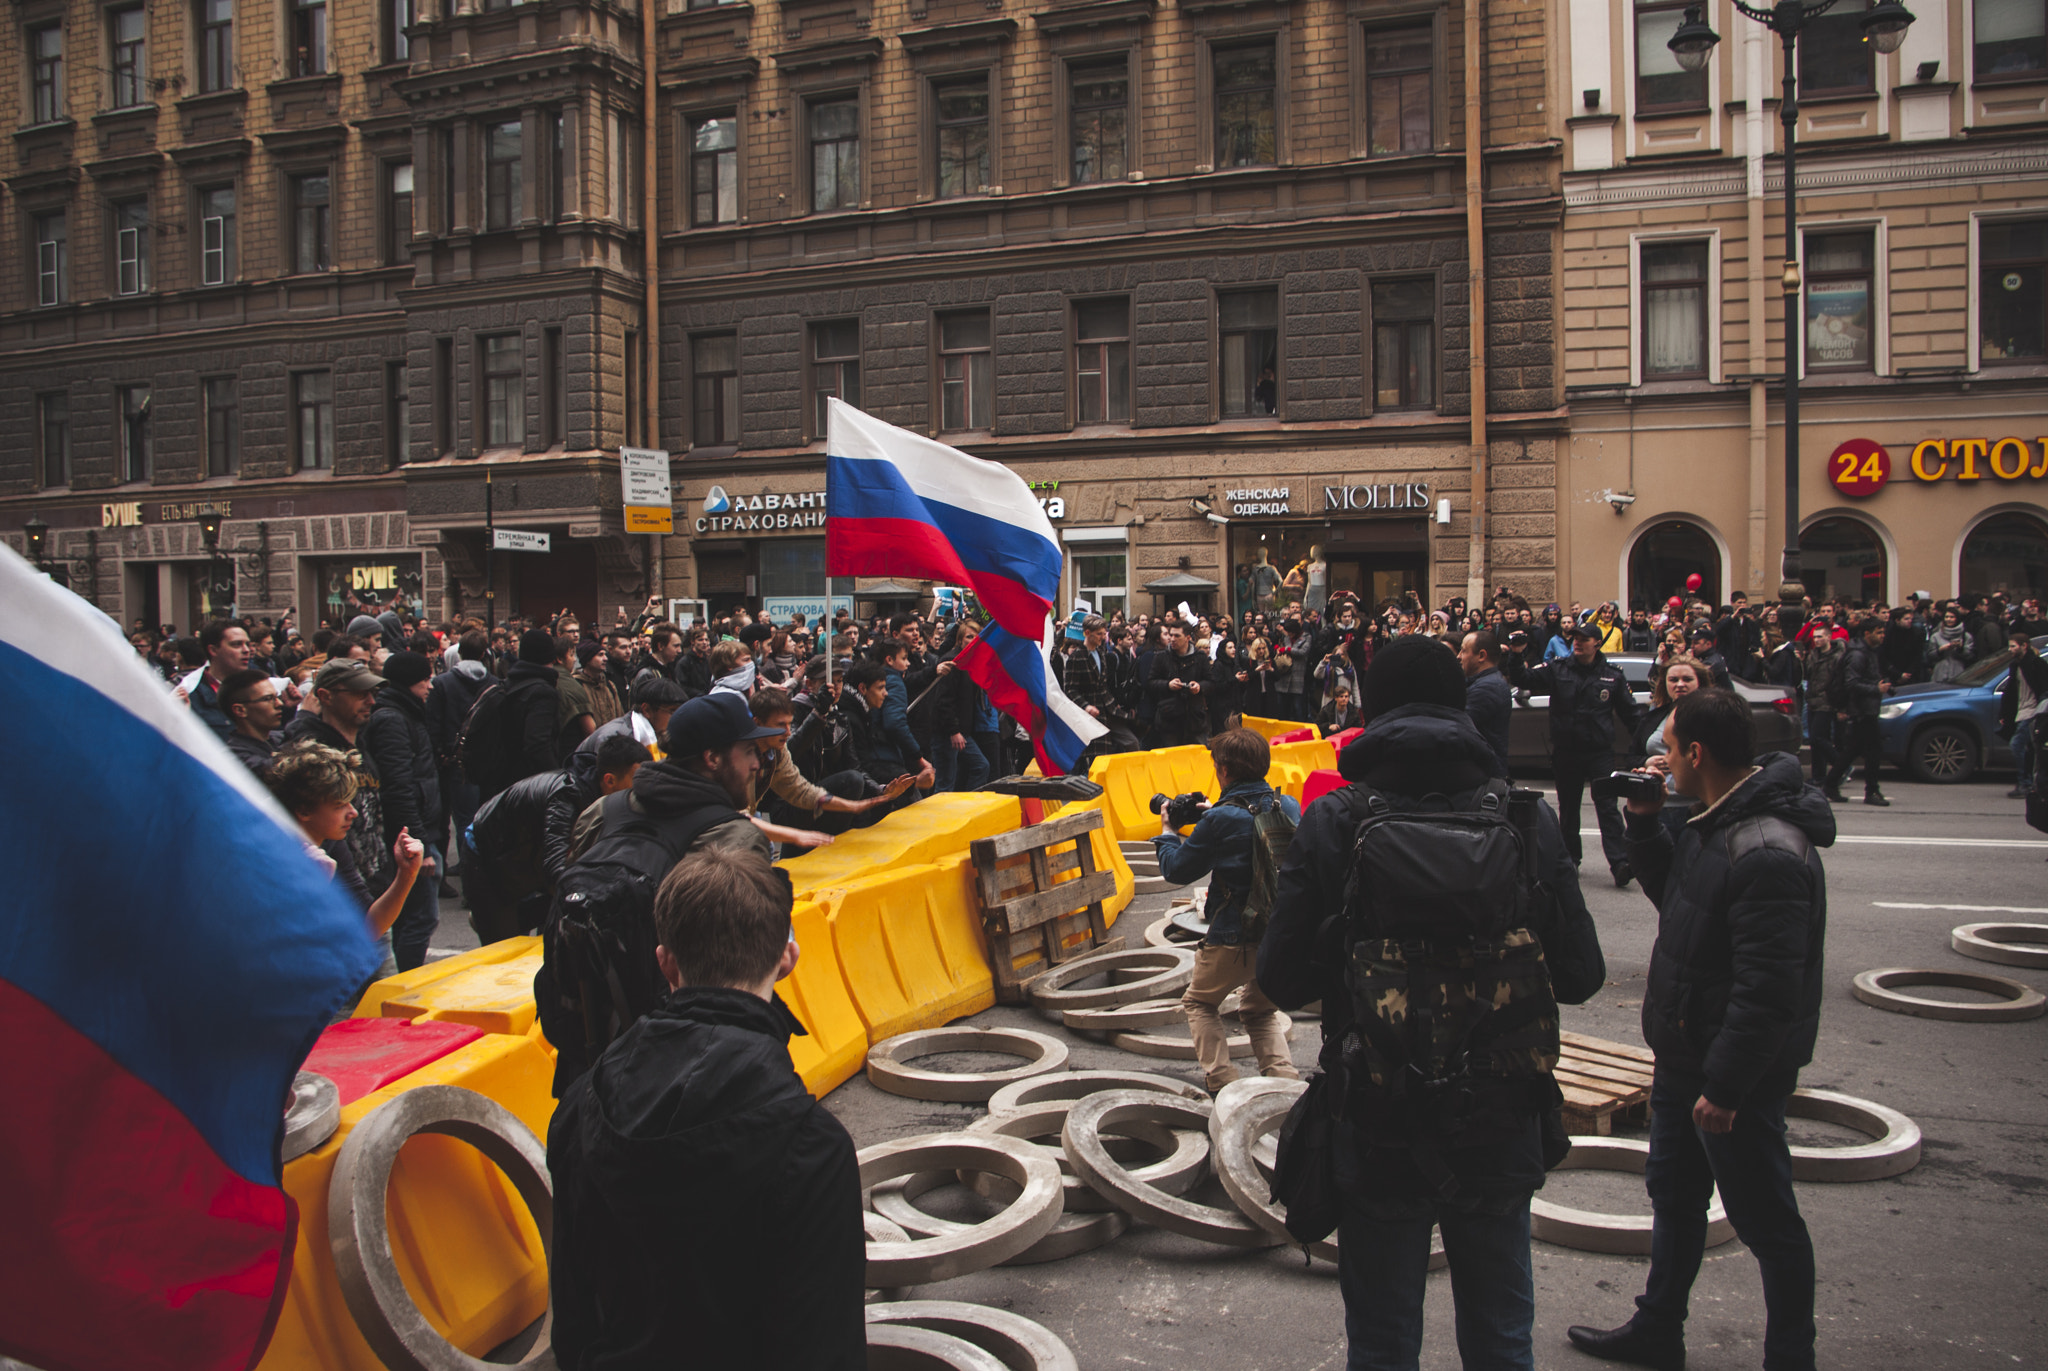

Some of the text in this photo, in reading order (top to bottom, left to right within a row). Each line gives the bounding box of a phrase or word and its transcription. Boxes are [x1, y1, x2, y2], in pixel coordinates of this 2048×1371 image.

[1819, 349, 1854, 360] ЧАСОВ
[1836, 452, 1883, 483] 24
[1226, 487, 1289, 500] ЖЕНСКАЯ
[1324, 483, 1429, 510] MOLLIS
[102, 502, 143, 527] БУШЕ
[161, 504, 181, 520] ЕСТЬ
[1233, 502, 1290, 516] ОДЕЖДА
[497, 532, 535, 541] СТРЕМЯННАЯ
[352, 565, 398, 590] БУШЕ
[770, 604, 847, 615] СТРАХОВАИЕ
